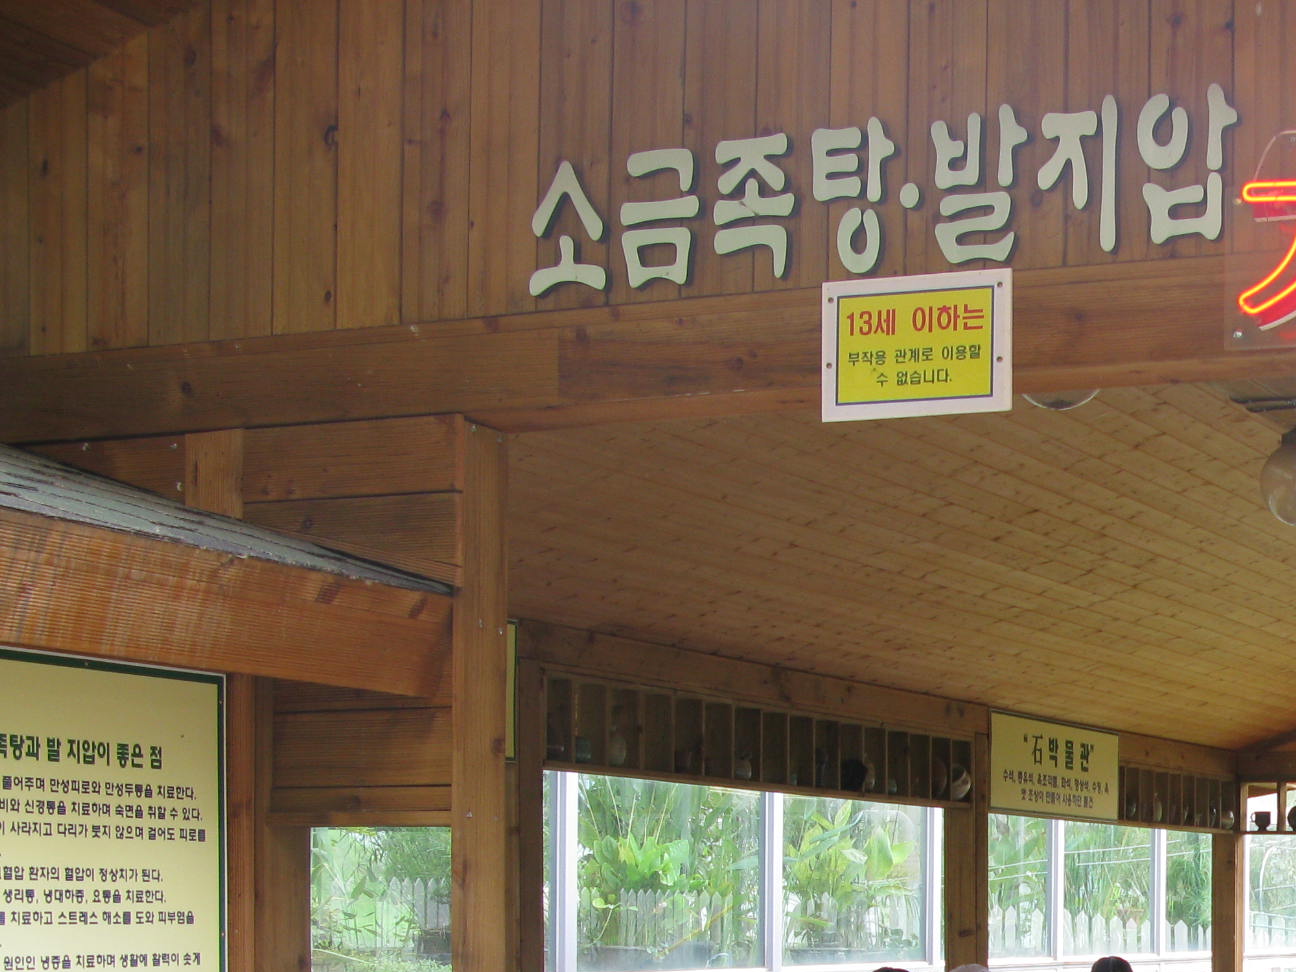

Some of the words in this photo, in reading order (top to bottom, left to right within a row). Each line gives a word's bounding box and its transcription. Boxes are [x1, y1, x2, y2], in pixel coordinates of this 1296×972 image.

[846, 308, 896, 337] 13세
[912, 303, 985, 333] 이하는
[848, 350, 887, 366] 부작용
[895, 346, 934, 364] 관계로
[942, 344, 981, 361] 이용할
[876, 371, 888, 387] 수
[896, 367, 952, 386] 없습니다.
[47, 736, 62, 763] 발
[67, 738, 110, 767] 지압이
[117, 742, 144, 769] 좋은
[150, 745, 163, 770] 점
[50, 778, 101, 796] 만성피로와
[105, 782, 153, 799] 만성두통을
[157, 784, 197, 801] 치료한다.
[25, 799, 67, 816] 신경통을
[71, 801, 111, 817] 치료하며
[115, 803, 144, 820] 숙면을
[148, 805, 167, 821] 취할
[169, 806, 179, 819] 수
[182, 807, 203, 822] 있다.
[10, 821, 53, 837] 사라지고
[57, 823, 88, 839] 다리가
[91, 825, 111, 840] 붓지
[115, 826, 144, 841] 않으며
[148, 827, 176, 841] 걸어도
[179, 828, 207, 843] 피로를
[0, 866, 25, 881] 혈압
[29, 866, 60, 881] 환자의
[64, 866, 95, 882] 혈압이
[99, 867, 139, 882] 정상치가
[141, 868, 164, 883] 된다.
[3, 888, 39, 905] 생리통,
[43, 888, 88, 905] 냉대하증,
[92, 888, 122, 904] 요통을
[125, 889, 167, 904] 치료한다.
[10, 910, 53, 926] 치료하고
[57, 911, 99, 926] 스트레스
[102, 910, 131, 925] 해소를
[135, 911, 155, 925] 도와
[3, 955, 36, 972] 원인인
[40, 954, 71, 971] 냉증을
[75, 953, 116, 969] 치료하며
[119, 953, 148, 969] 생활에
[152, 952, 180, 967] 활력이
